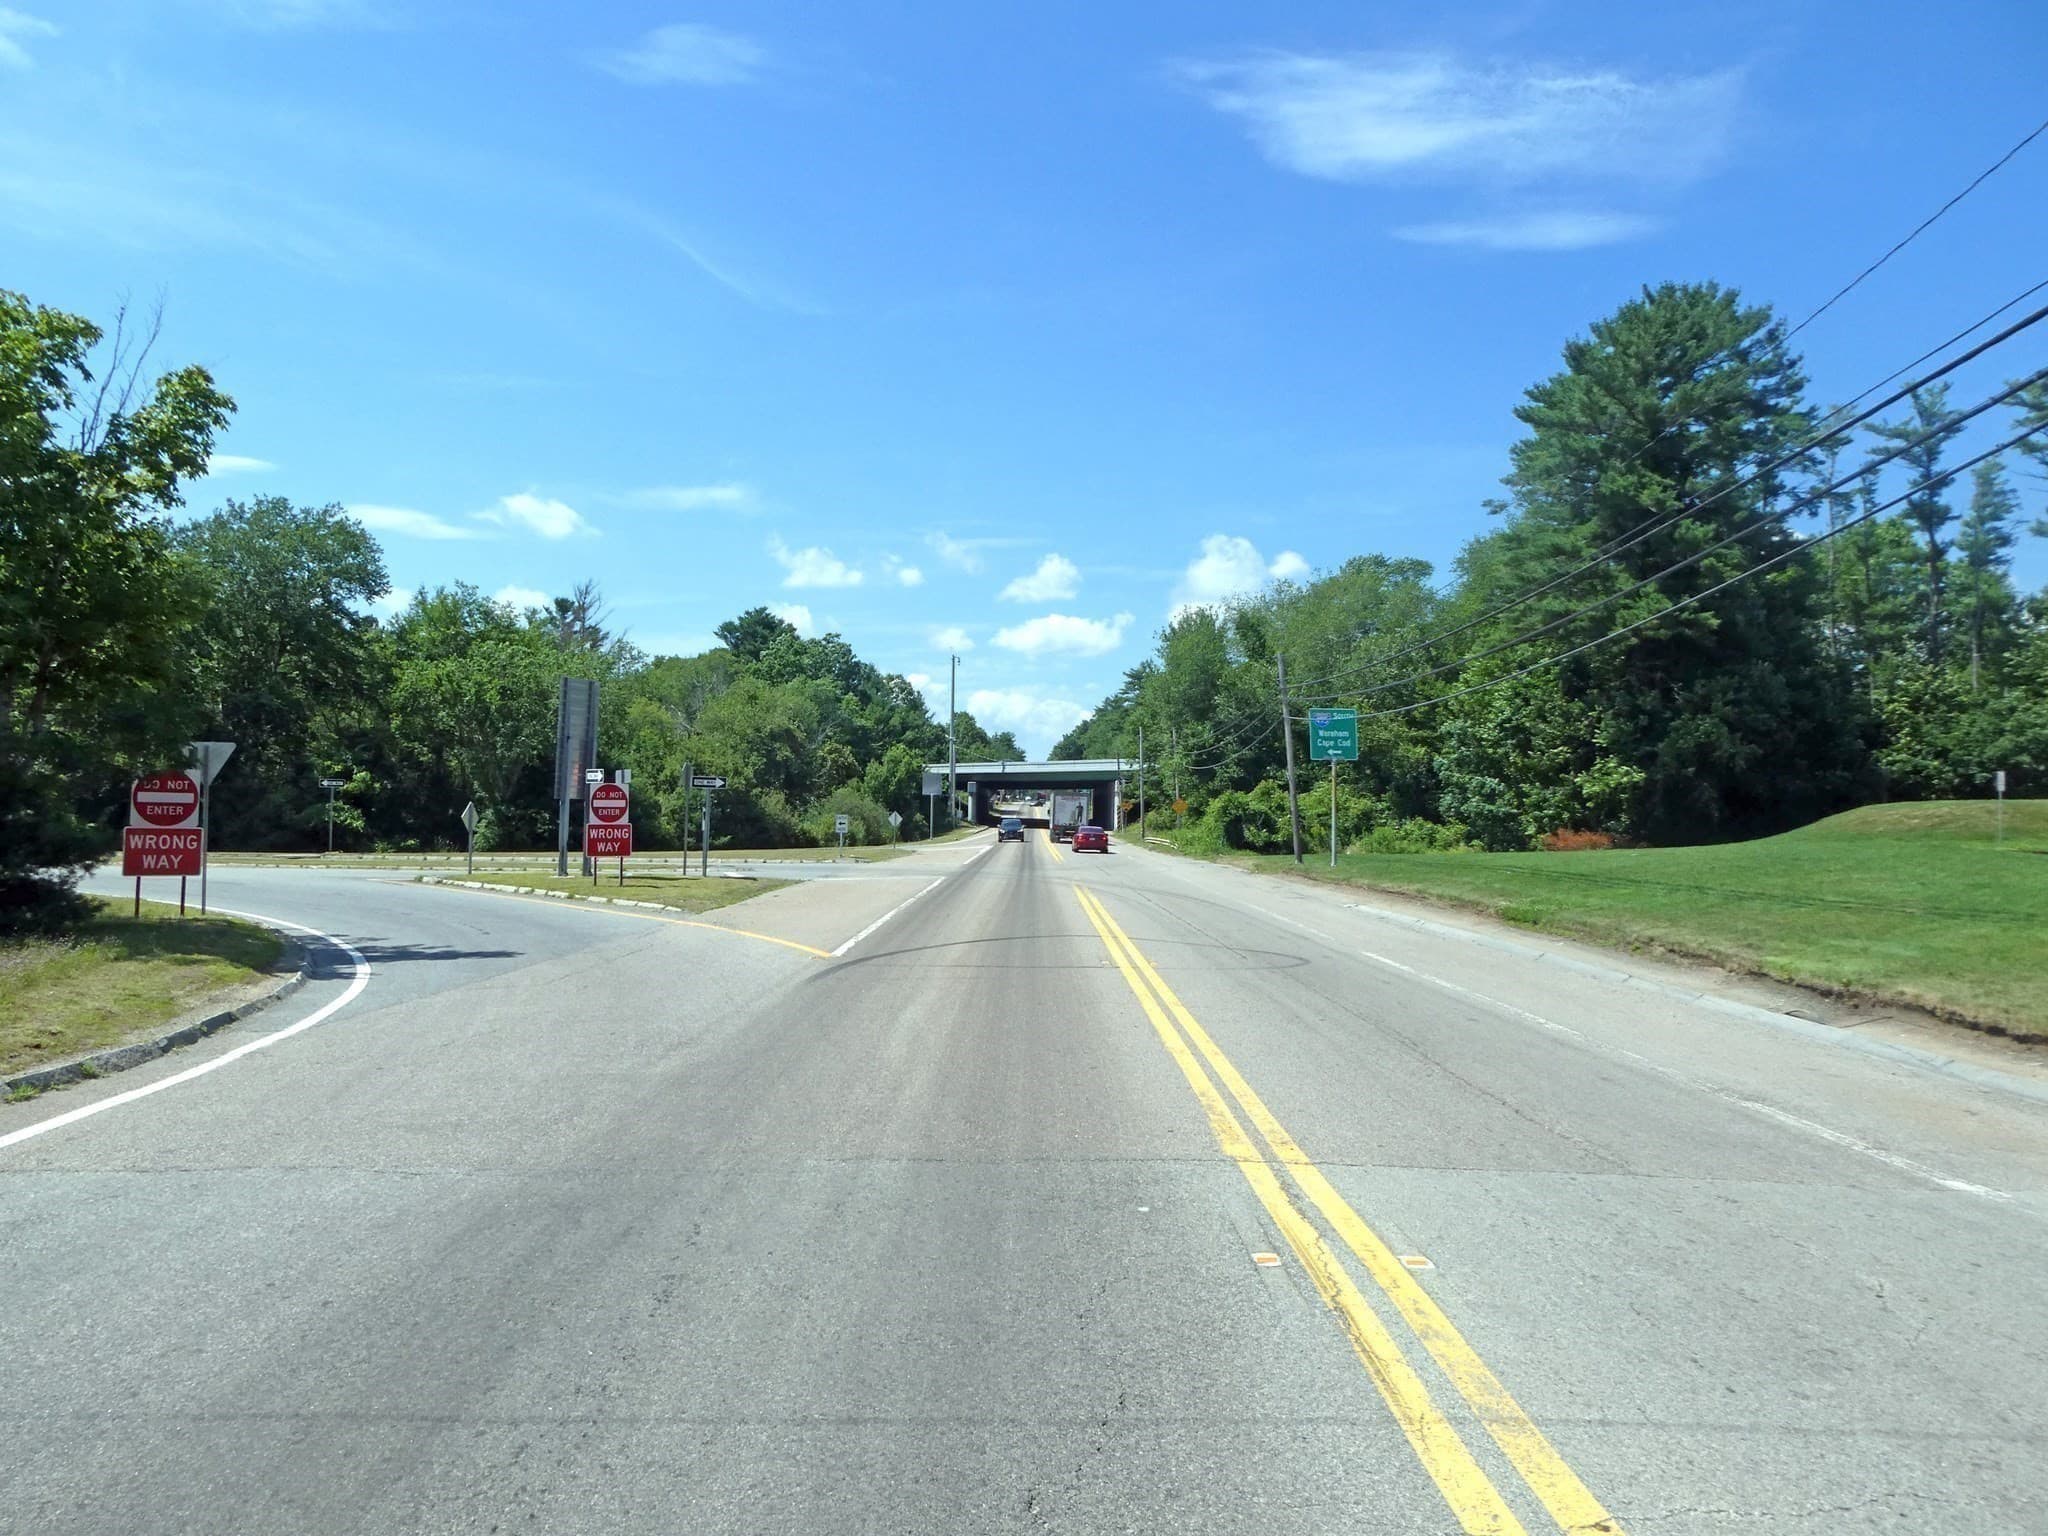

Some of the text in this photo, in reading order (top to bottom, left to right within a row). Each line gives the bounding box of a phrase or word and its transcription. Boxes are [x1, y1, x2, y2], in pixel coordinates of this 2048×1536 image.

[167, 780, 190, 790] NOT
[146, 805, 184, 816] ENTER
[590, 828, 630, 839] WRONG
[130, 834, 198, 850] WRONG
[596, 841, 621, 853] WAY
[142, 854, 183, 870] WAY
